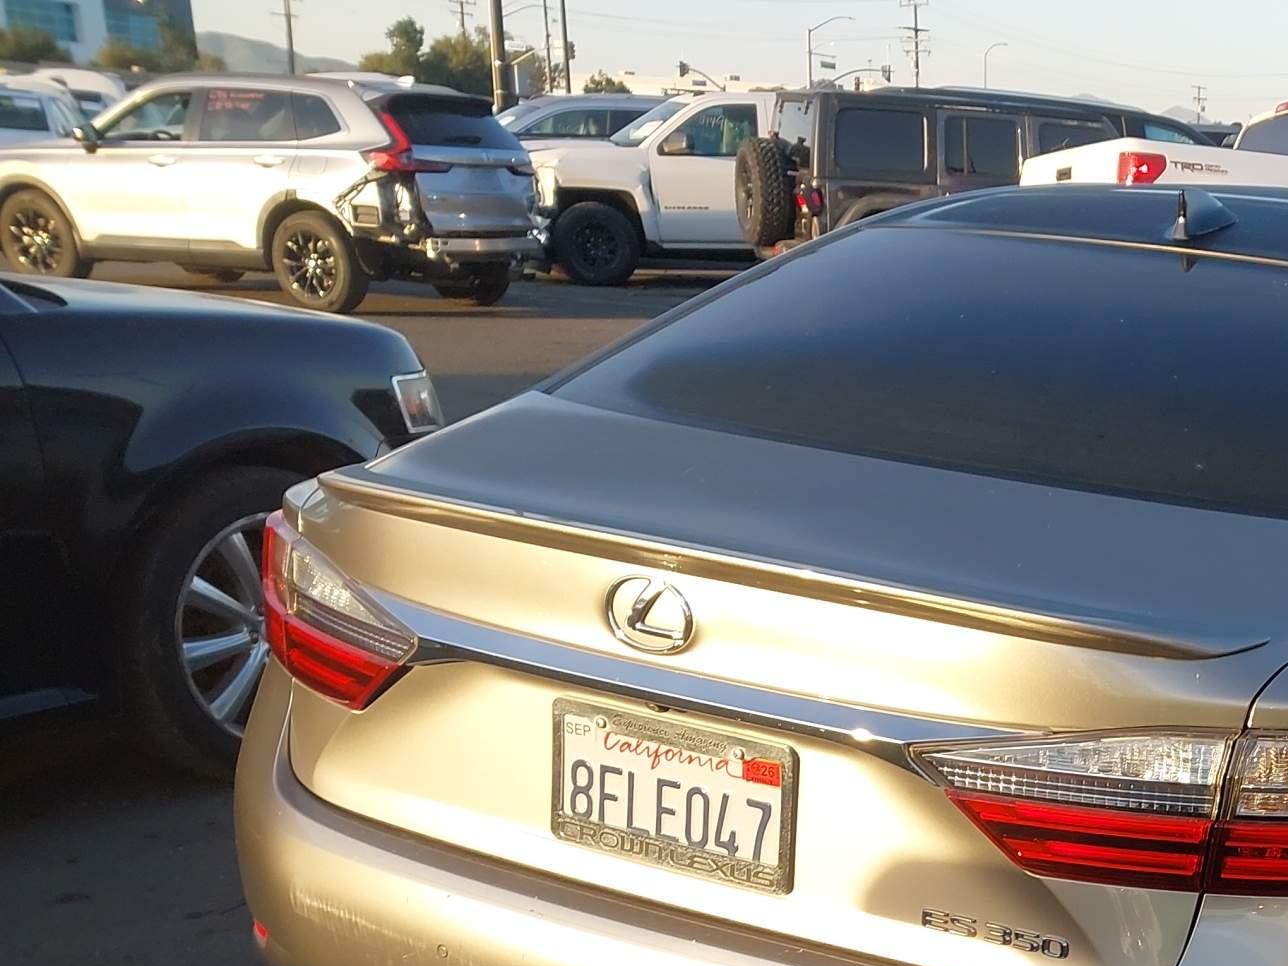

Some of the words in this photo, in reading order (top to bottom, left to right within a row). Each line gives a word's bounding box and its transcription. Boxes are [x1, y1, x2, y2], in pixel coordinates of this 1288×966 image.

[1170, 160, 1204, 172] TRD
[565, 721, 591, 736] SEP
[604, 730, 742, 777] California
[570, 759, 772, 863] 8FLE047
[668, 846, 775, 887] LEXUS
[922, 907, 977, 938] ES
[984, 921, 1070, 960] 350
